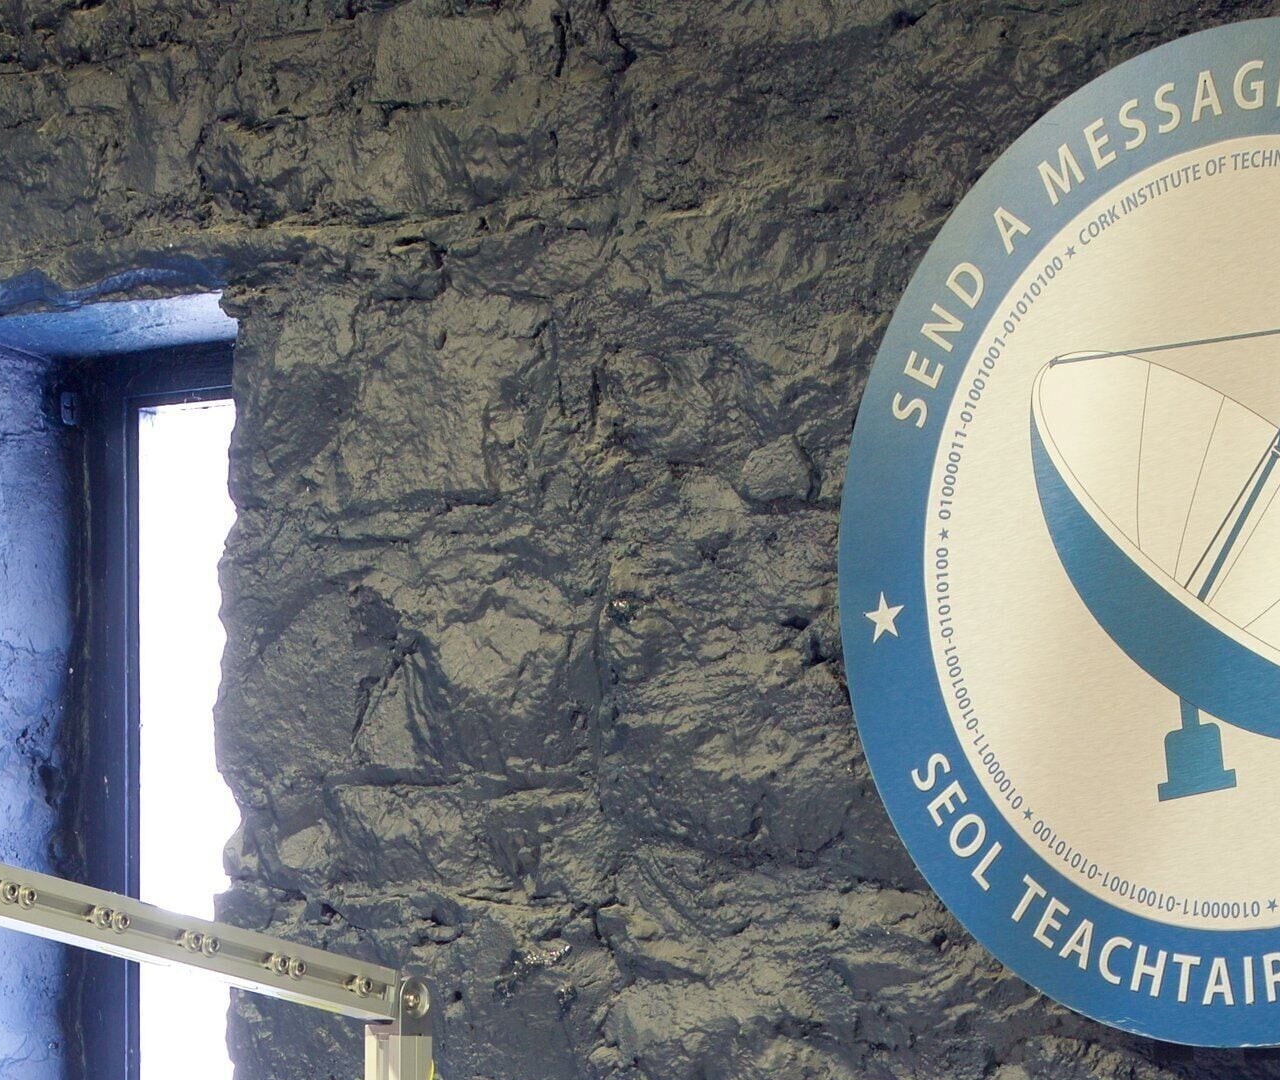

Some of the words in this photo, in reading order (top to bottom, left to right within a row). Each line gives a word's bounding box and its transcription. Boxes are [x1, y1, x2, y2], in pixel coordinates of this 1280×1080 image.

[1079, 205, 1120, 246] CORK
[1122, 164, 1201, 215] INSTITUTE
[1205, 156, 1226, 177] OF
[892, 262, 985, 428] SEND
[993, 206, 1031, 255] A
[911, 753, 1002, 891] SEOL
